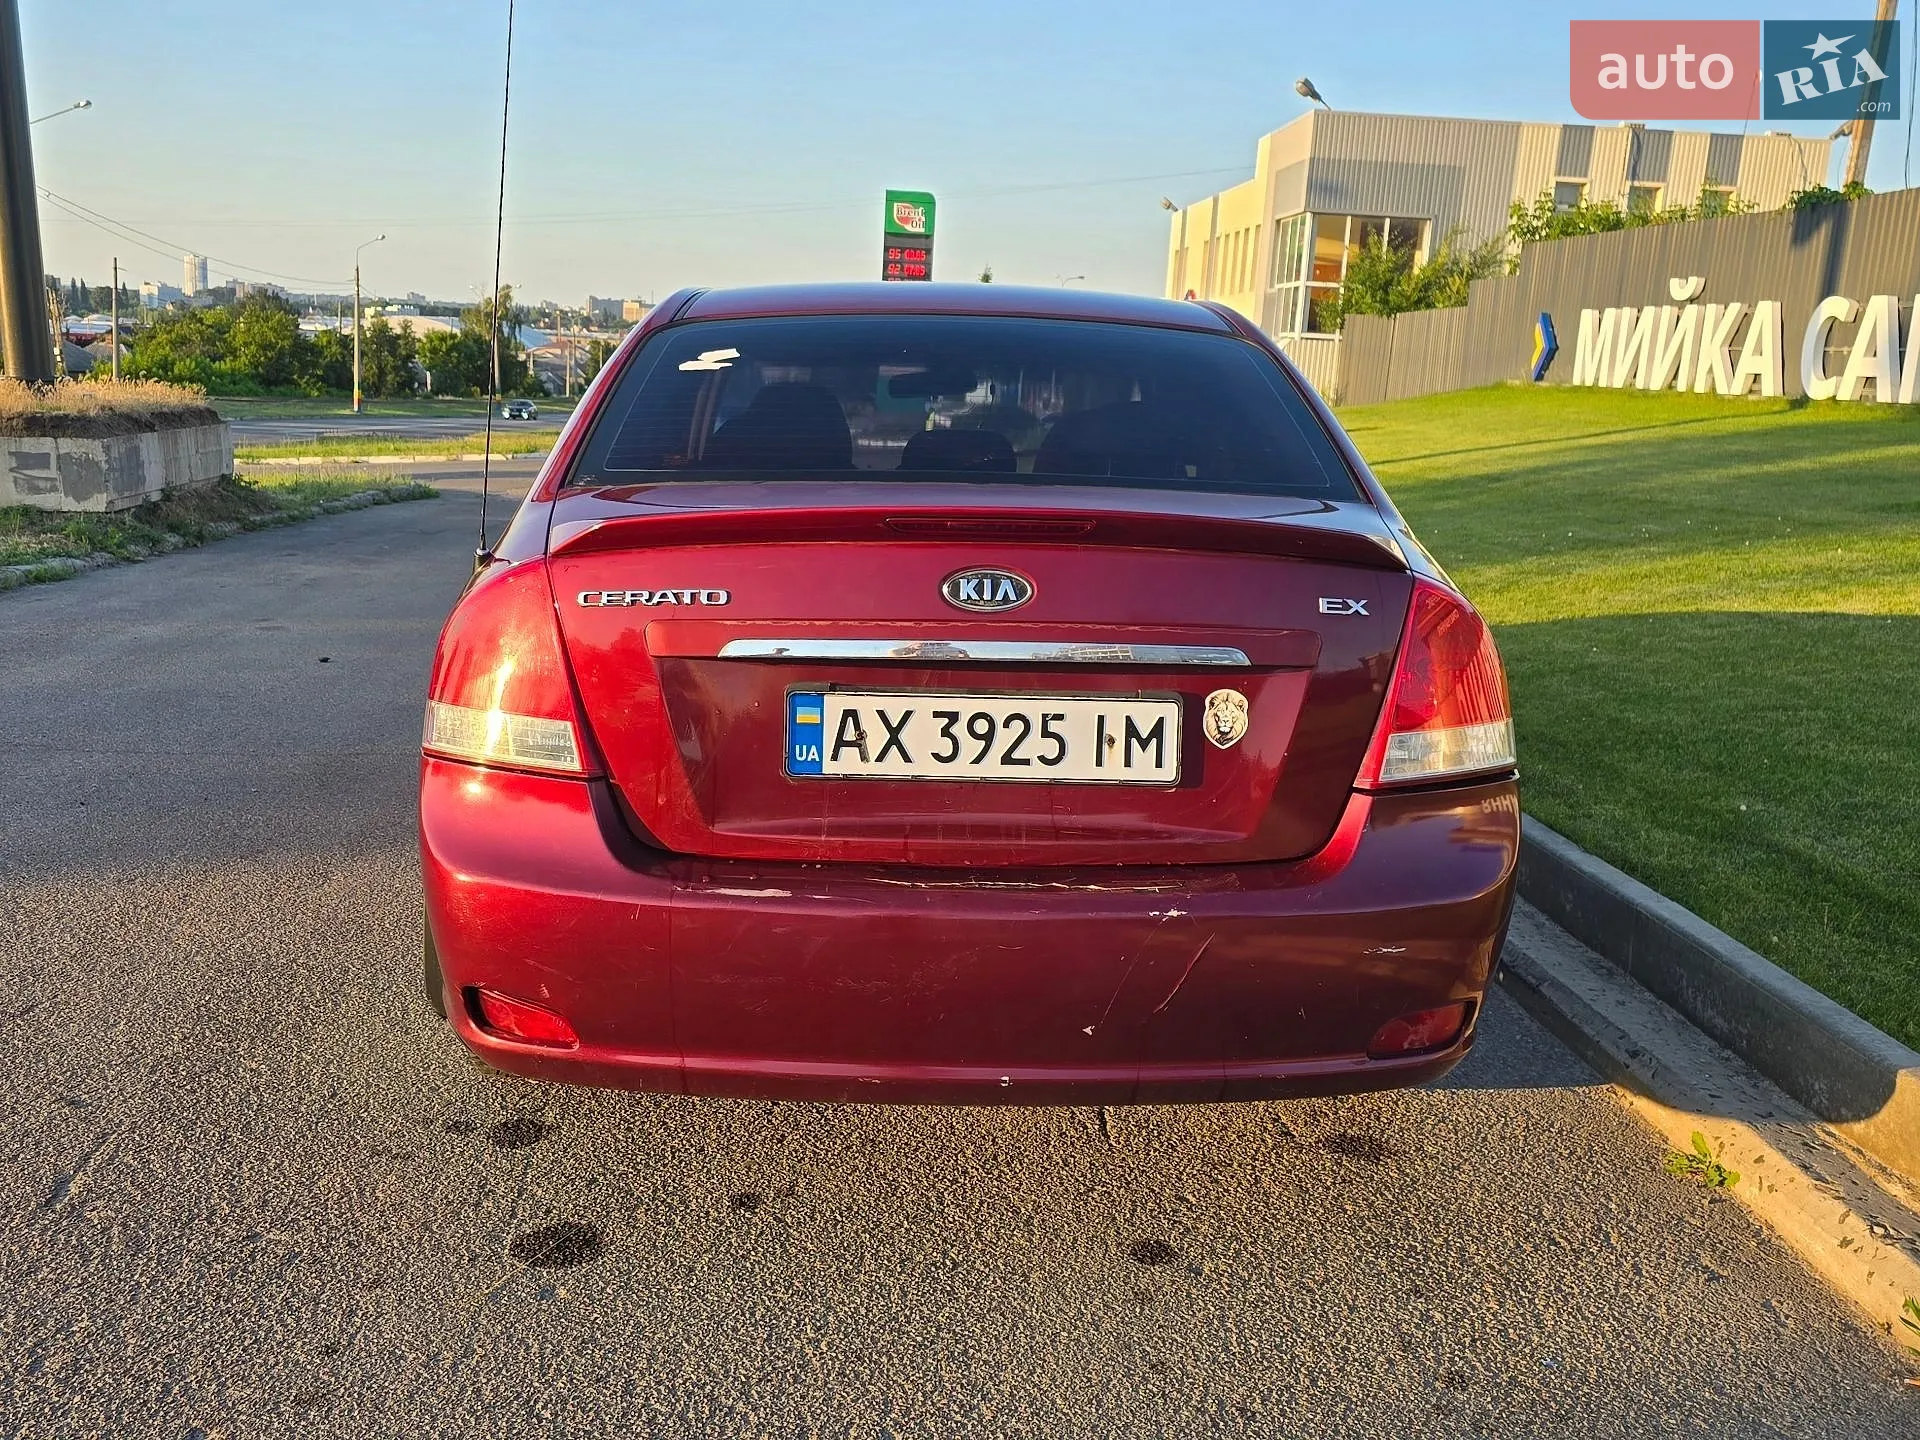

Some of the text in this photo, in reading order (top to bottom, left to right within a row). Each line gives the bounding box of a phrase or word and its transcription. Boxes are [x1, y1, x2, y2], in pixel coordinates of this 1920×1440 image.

[897, 205, 925, 217] Brent
[911, 216, 925, 229] Oil
[1572, 276, 1783, 397] МИЙКА
[577, 588, 732, 608] CERATO
[958, 578, 1018, 601] KIA
[1318, 597, 1370, 616] EX
[829, 708, 1165, 769] AX 3925 IM
[795, 744, 820, 761] UA
